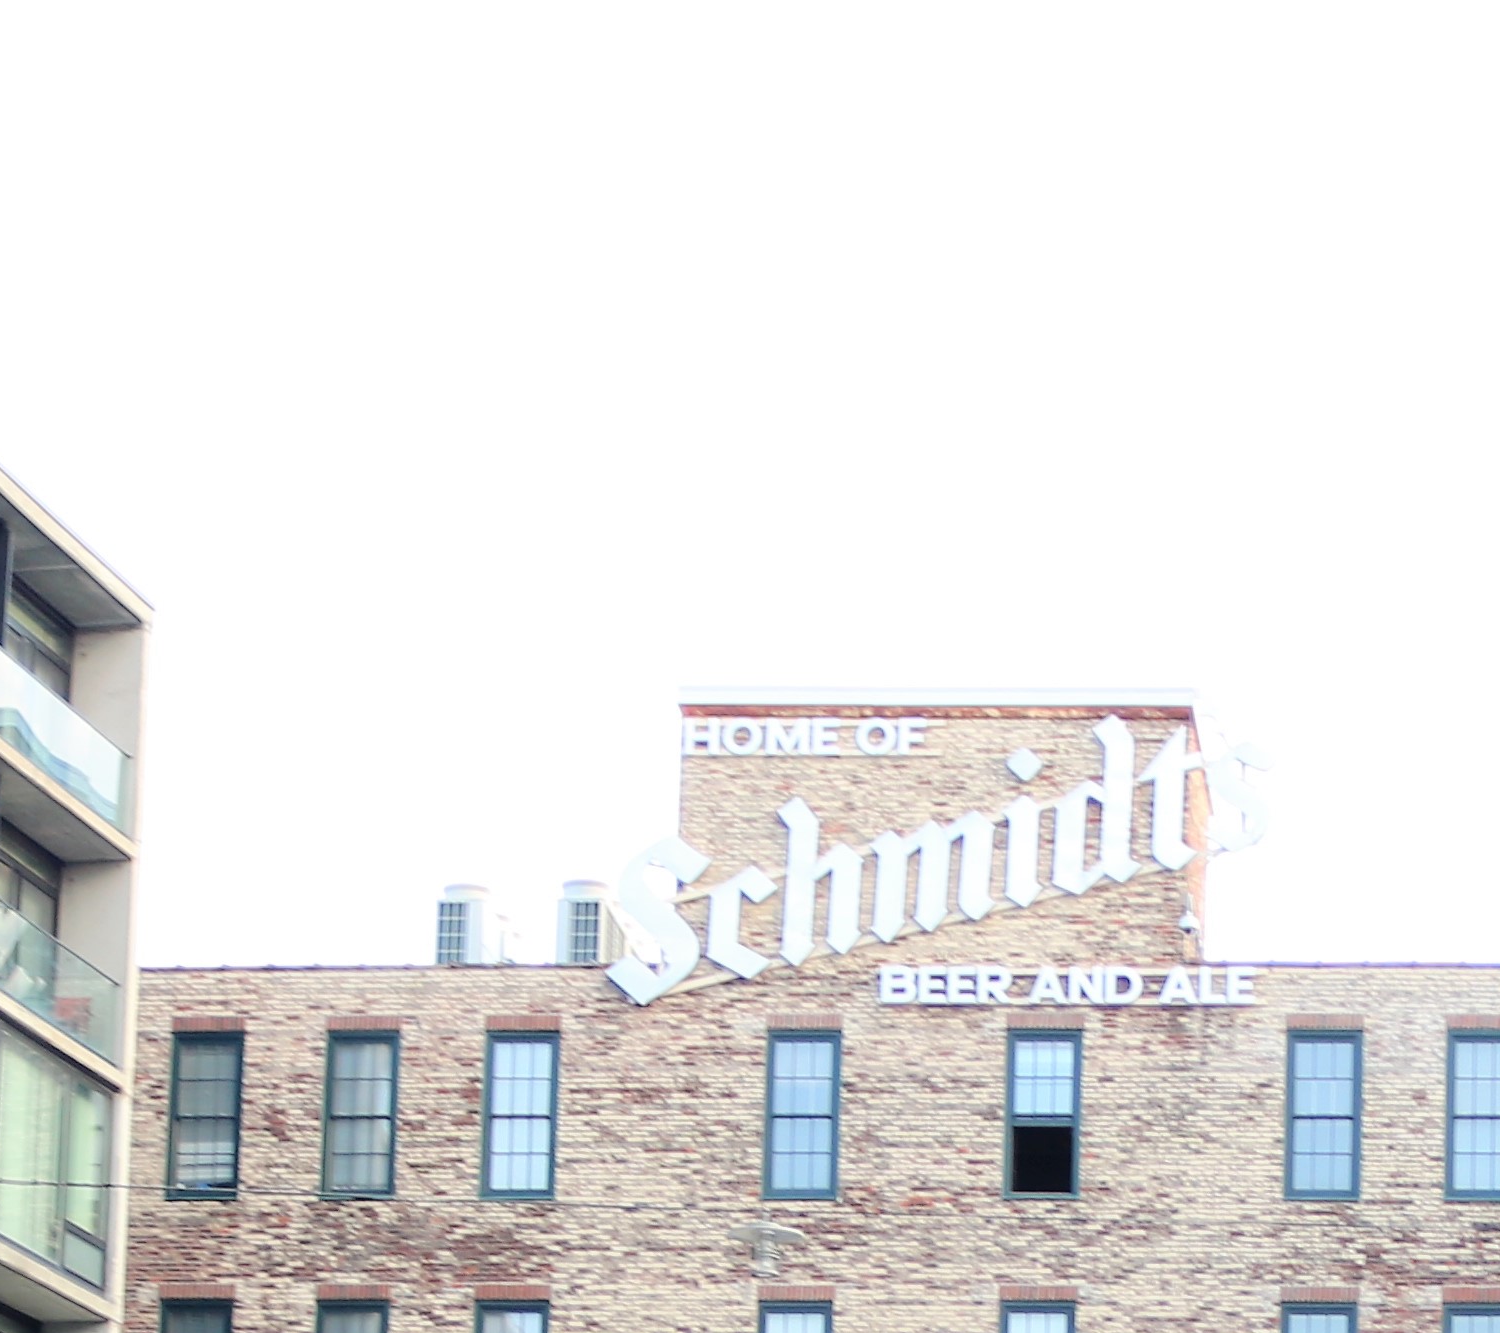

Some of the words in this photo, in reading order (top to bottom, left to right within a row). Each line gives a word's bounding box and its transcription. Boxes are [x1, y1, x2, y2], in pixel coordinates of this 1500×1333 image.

[682, 716, 840, 757] HOME
[855, 716, 928, 757] OF
[879, 965, 1010, 1003] BEER
[1028, 966, 1143, 1002] AND
[1160, 966, 1257, 1003] ALE
